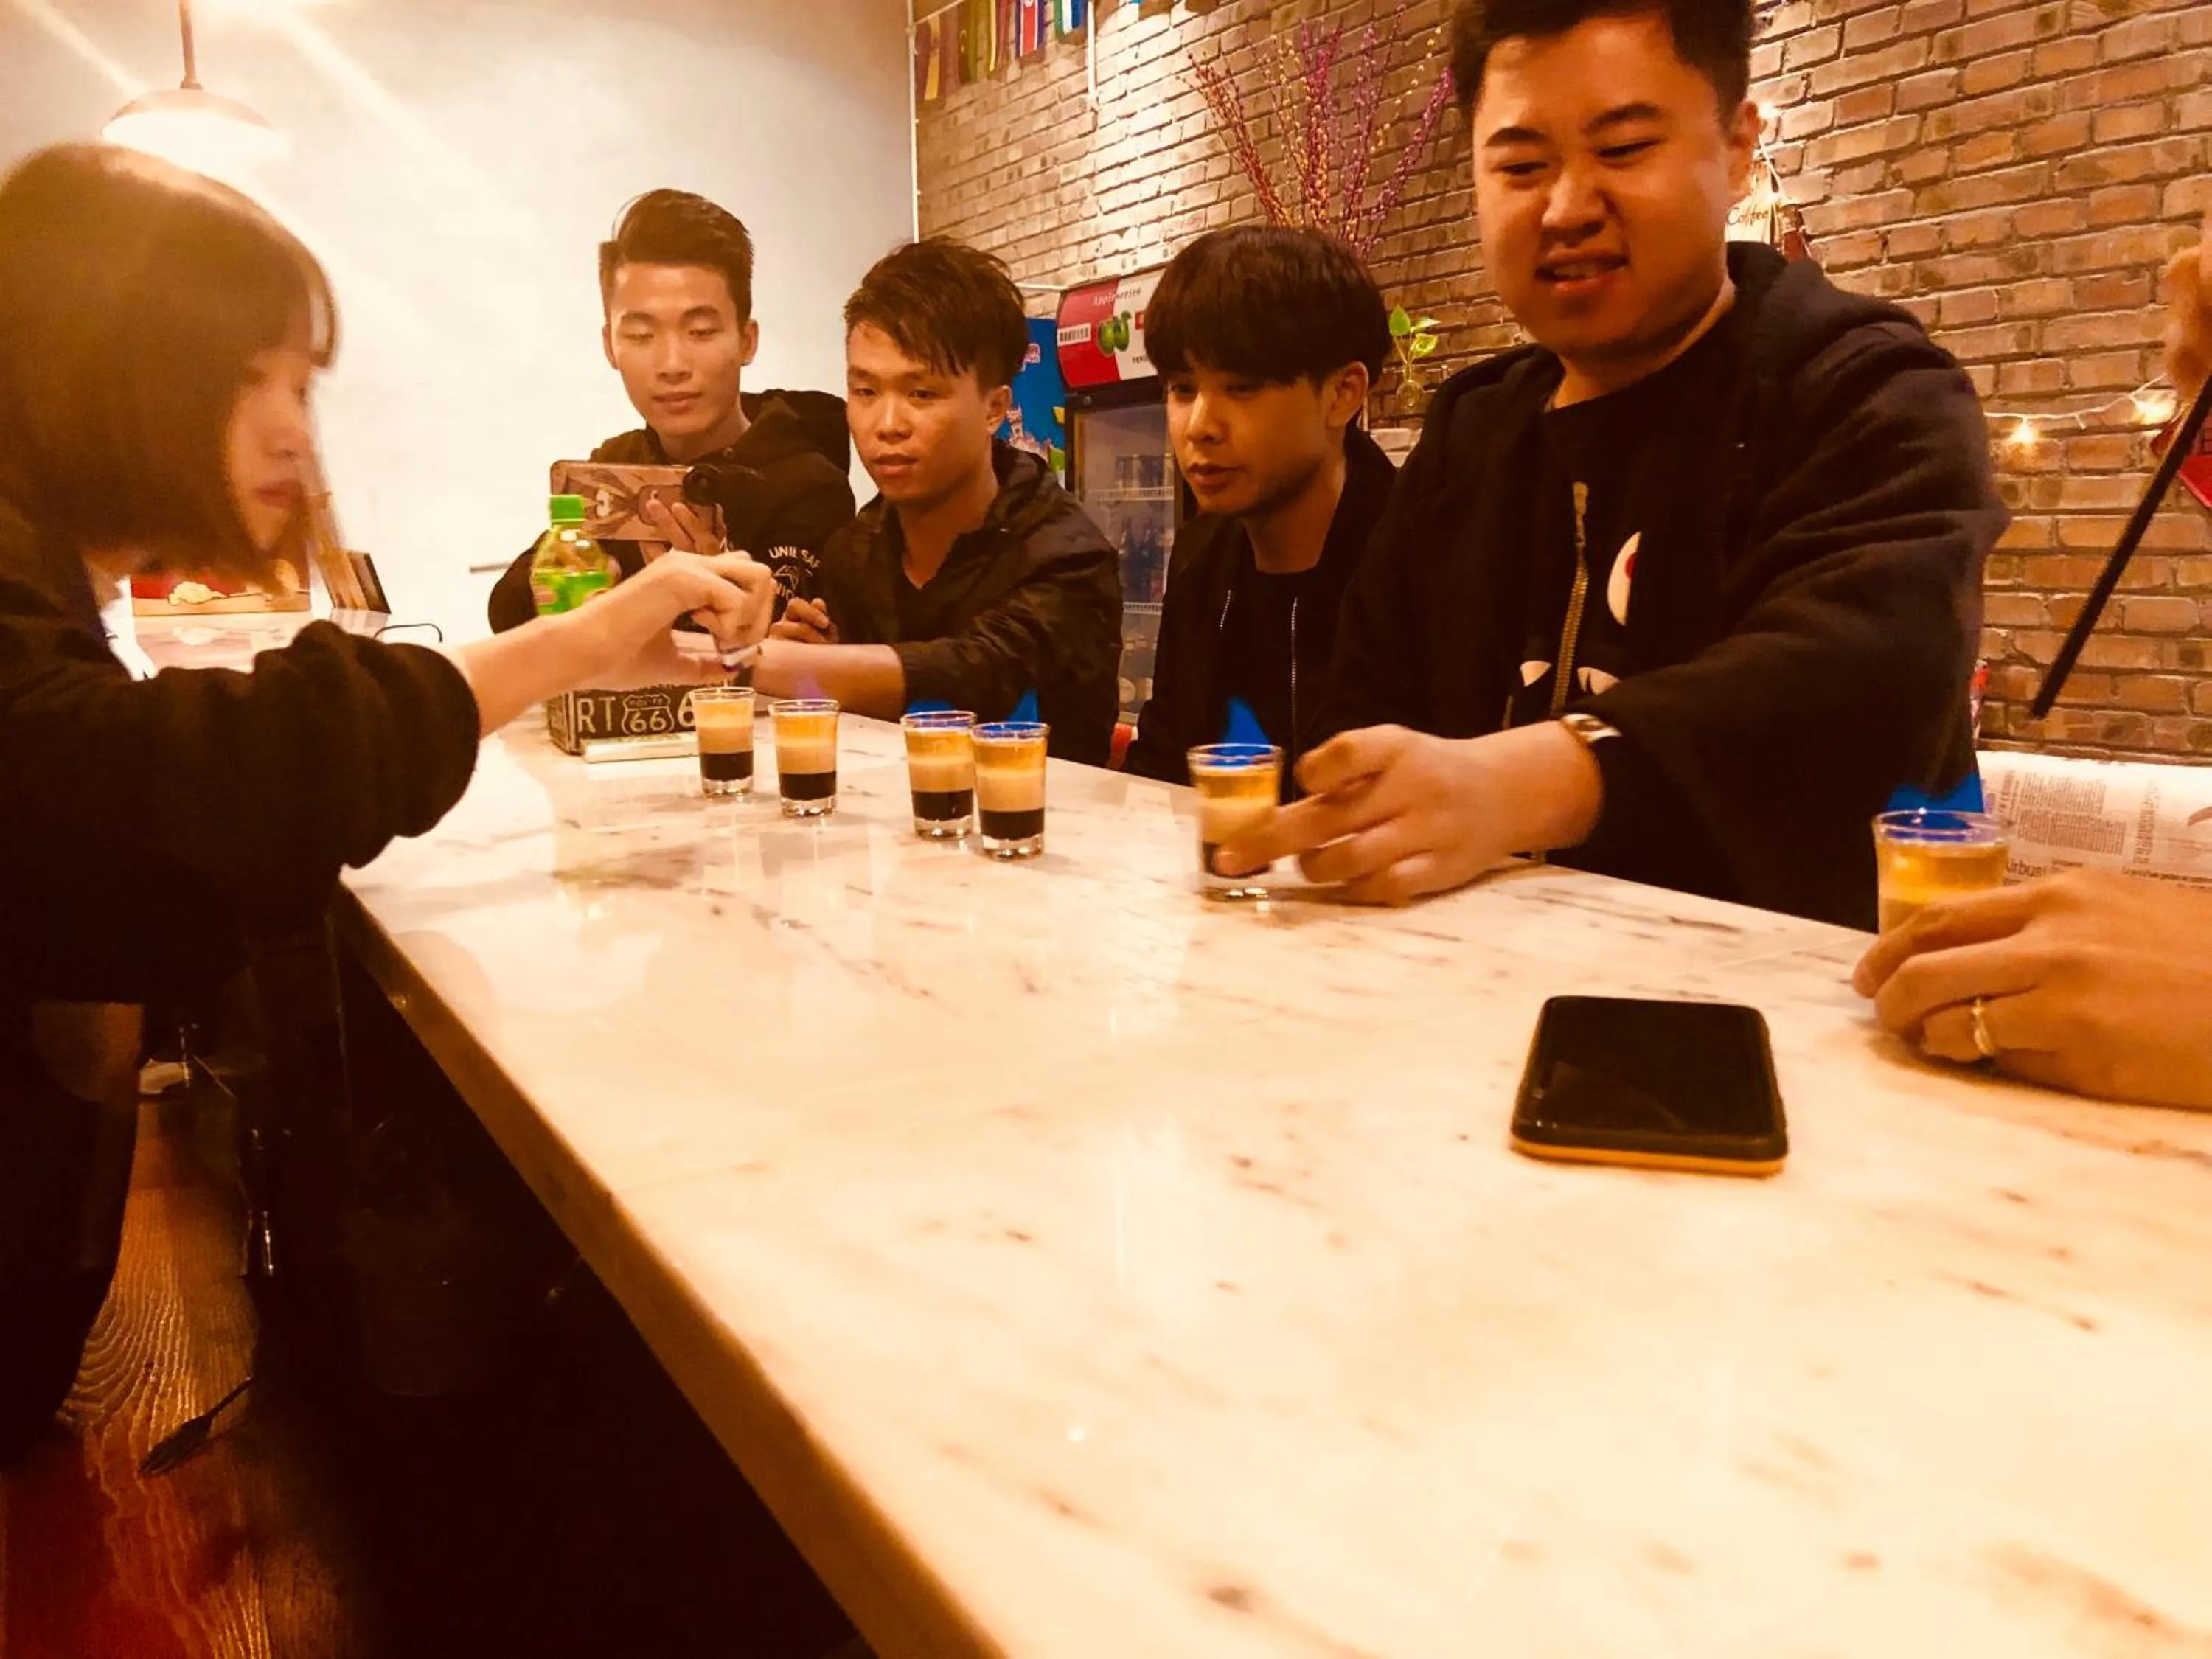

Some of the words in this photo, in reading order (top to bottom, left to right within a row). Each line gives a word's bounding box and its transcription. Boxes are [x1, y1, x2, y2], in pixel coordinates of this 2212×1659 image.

[1728, 204, 1769, 226] Coffee
[577, 695, 616, 733] RT
[629, 710, 667, 732] 66
